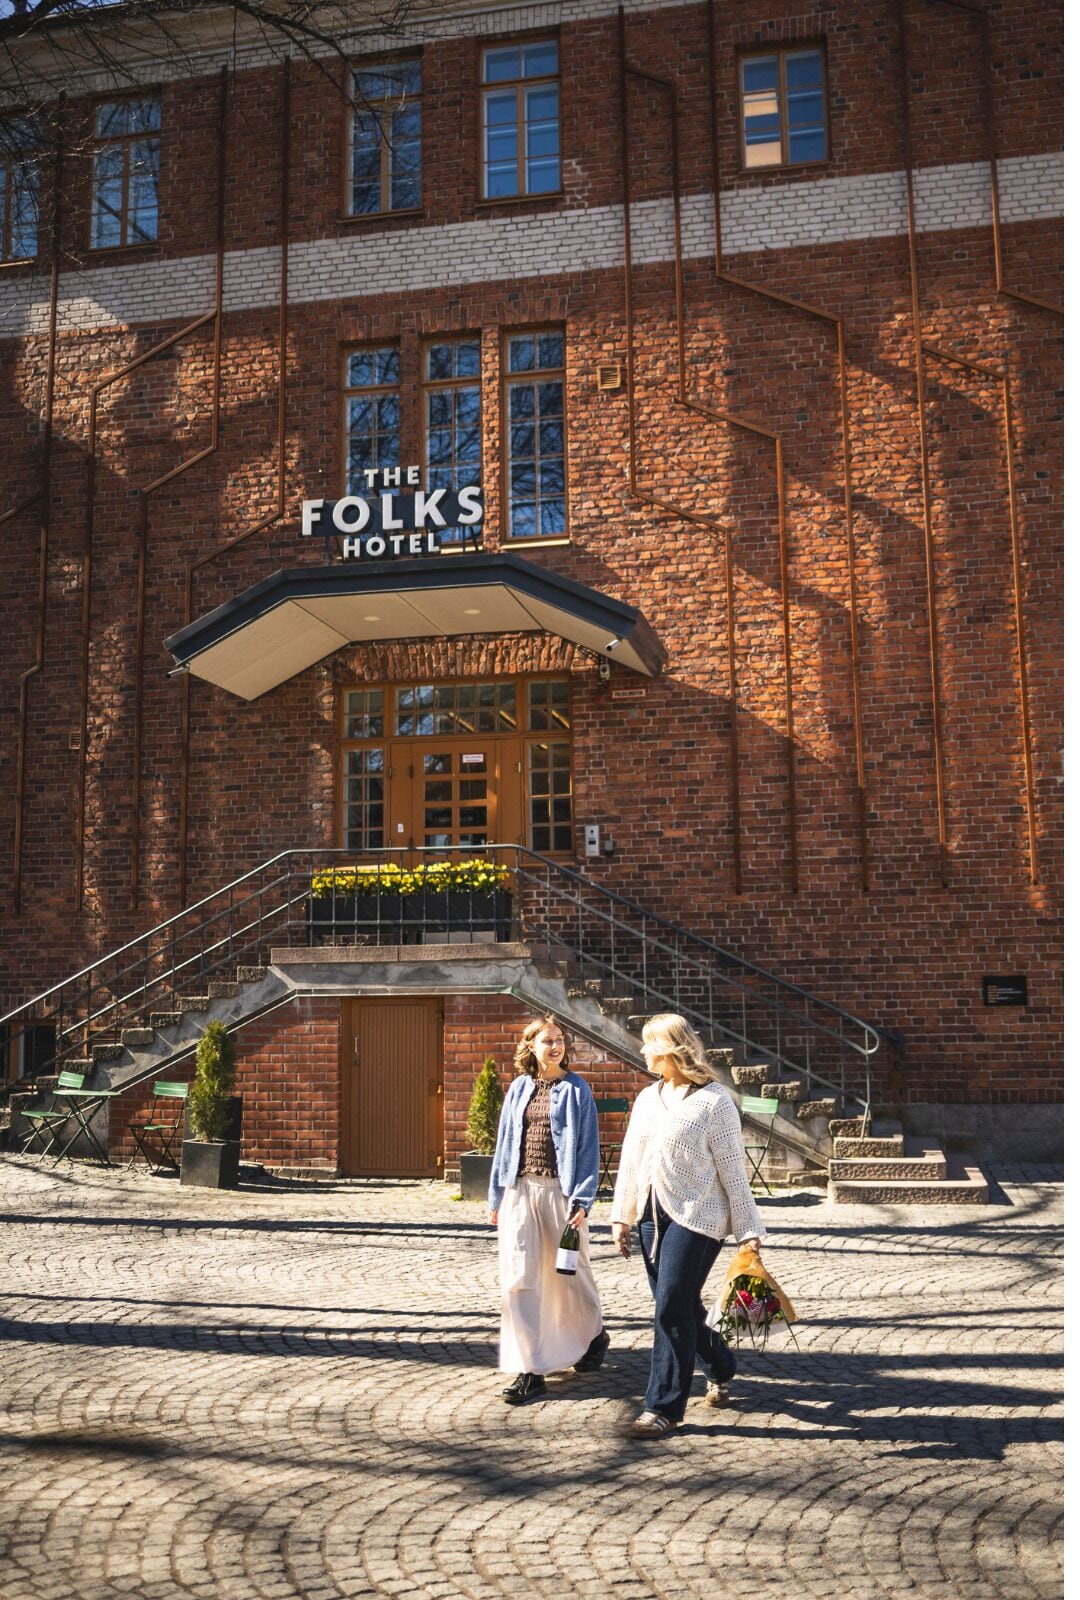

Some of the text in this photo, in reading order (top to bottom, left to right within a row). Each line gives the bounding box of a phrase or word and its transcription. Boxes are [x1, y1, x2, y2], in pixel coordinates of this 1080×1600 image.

[364, 465, 420, 488] THE
[301, 486, 483, 536] FOLKS
[343, 532, 440, 558] HOTEL
